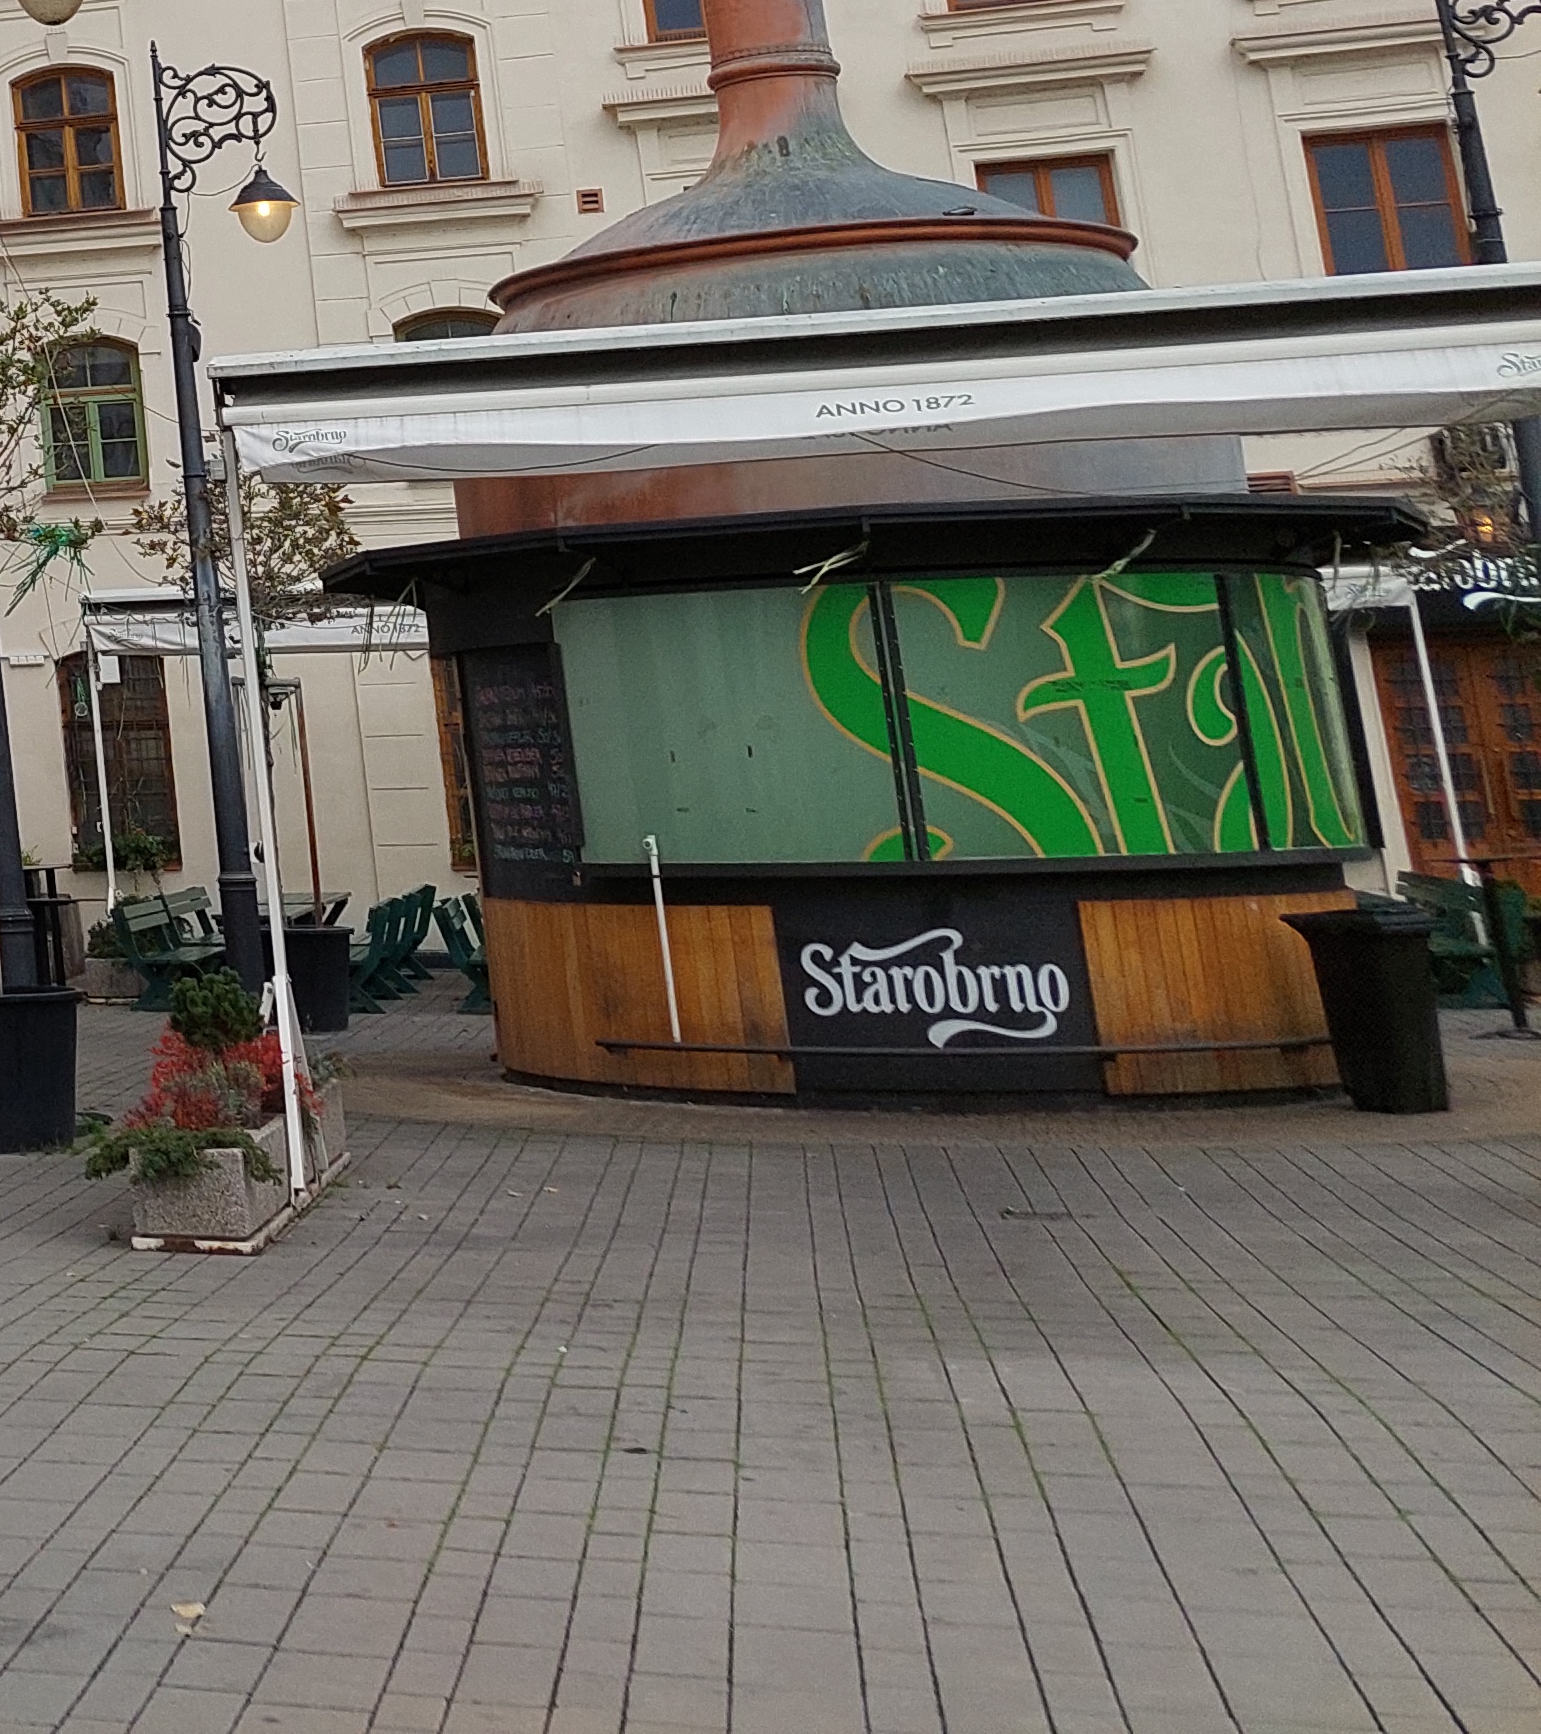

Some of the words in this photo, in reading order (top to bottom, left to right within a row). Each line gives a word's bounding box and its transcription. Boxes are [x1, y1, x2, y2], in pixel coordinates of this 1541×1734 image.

[815, 399, 905, 418] ANNO
[912, 394, 975, 412] 1872
[800, 928, 1070, 1049] Starobrno
